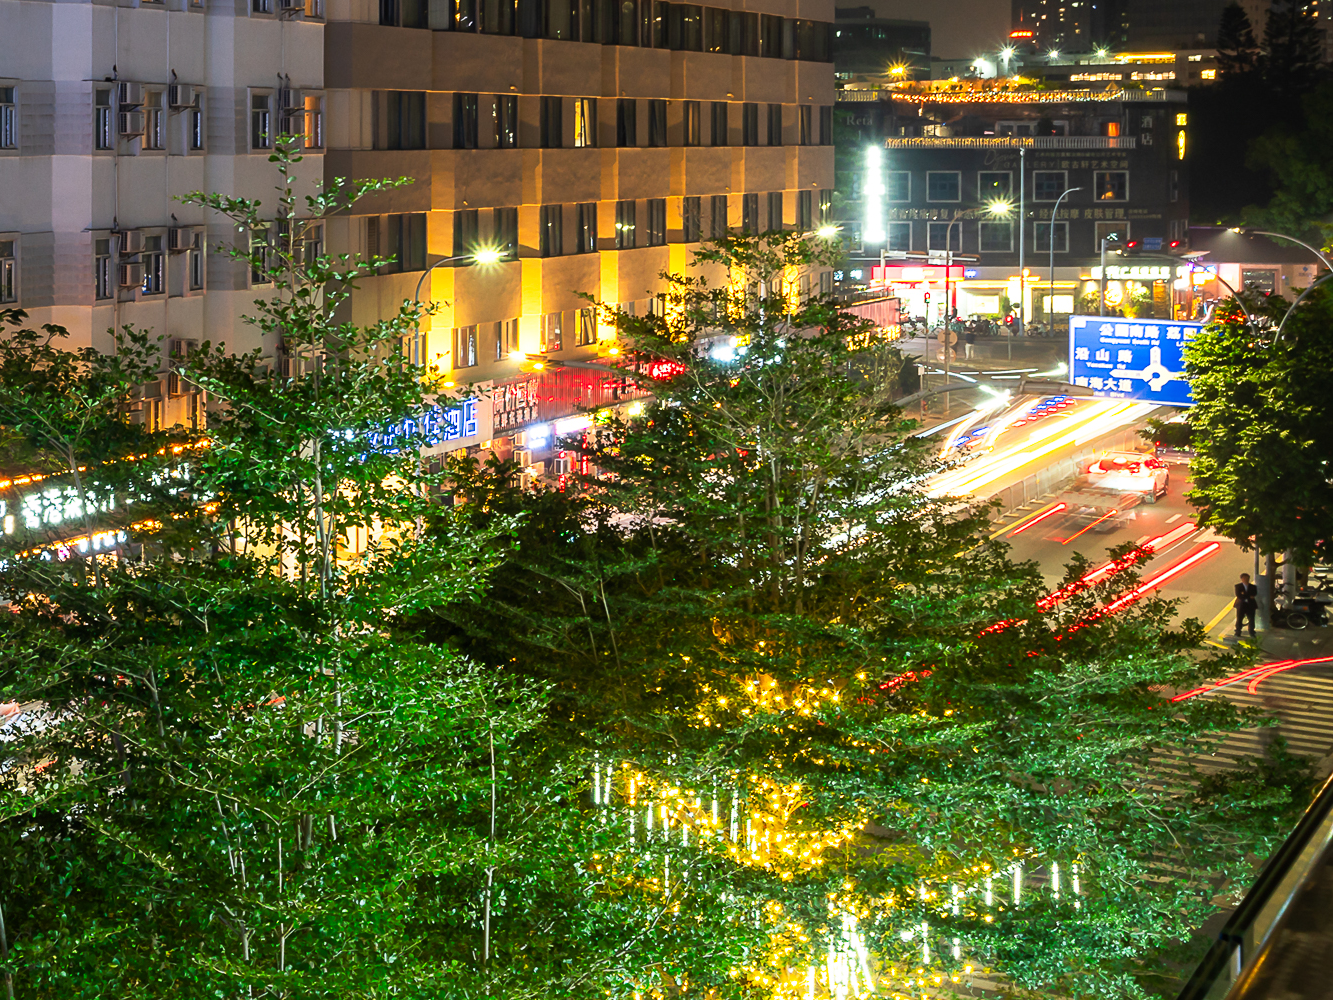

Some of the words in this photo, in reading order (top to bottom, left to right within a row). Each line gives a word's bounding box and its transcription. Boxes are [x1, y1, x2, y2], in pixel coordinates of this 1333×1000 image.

[1003, 161, 1056, 169] GALERY
[1084, 207, 1126, 220] 皮肤管理
